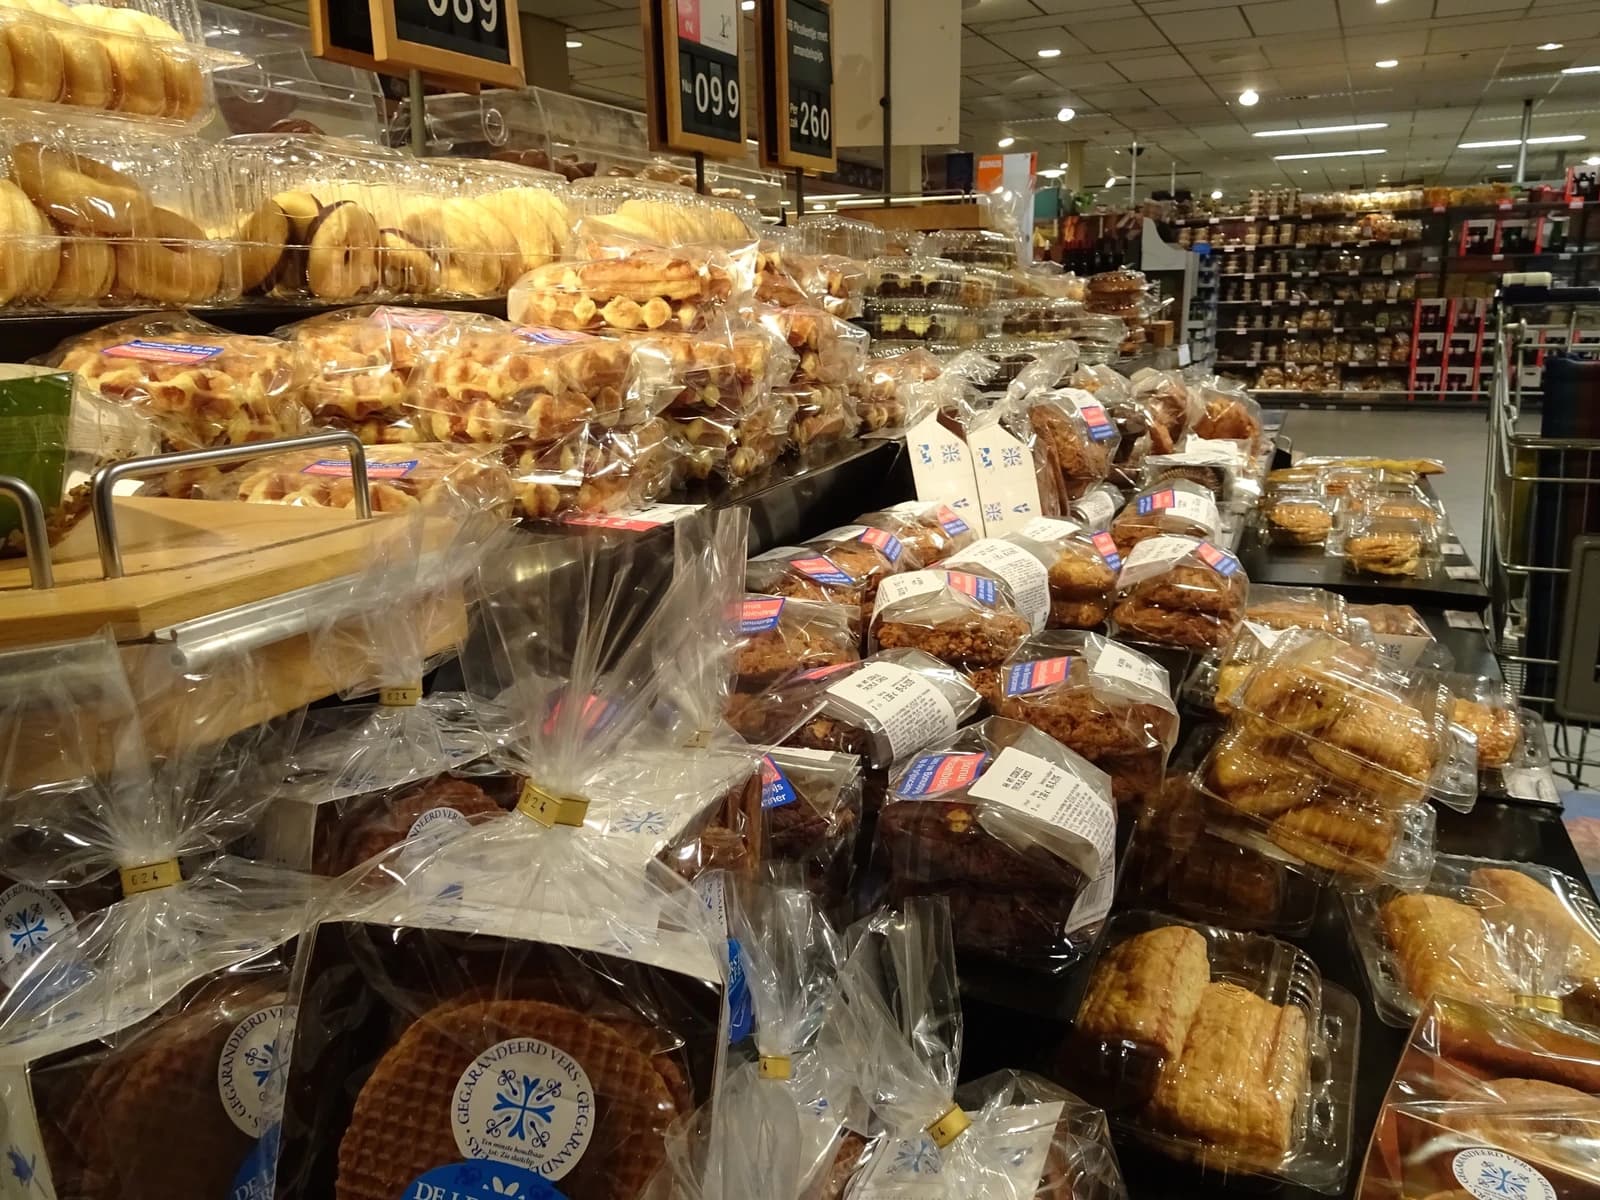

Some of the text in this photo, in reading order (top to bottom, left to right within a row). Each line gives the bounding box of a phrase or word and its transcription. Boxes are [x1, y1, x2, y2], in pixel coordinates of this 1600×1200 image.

[682, 72, 739, 119] Nu 099
[800, 101, 830, 141] 260
[410, 809, 442, 838] NDEERD
[221, 1012, 267, 1117] GEGARANDEERD
[457, 1040, 582, 1125] GEGARANDEERD VERS
[538, 1091, 591, 1174] GEGARAND
